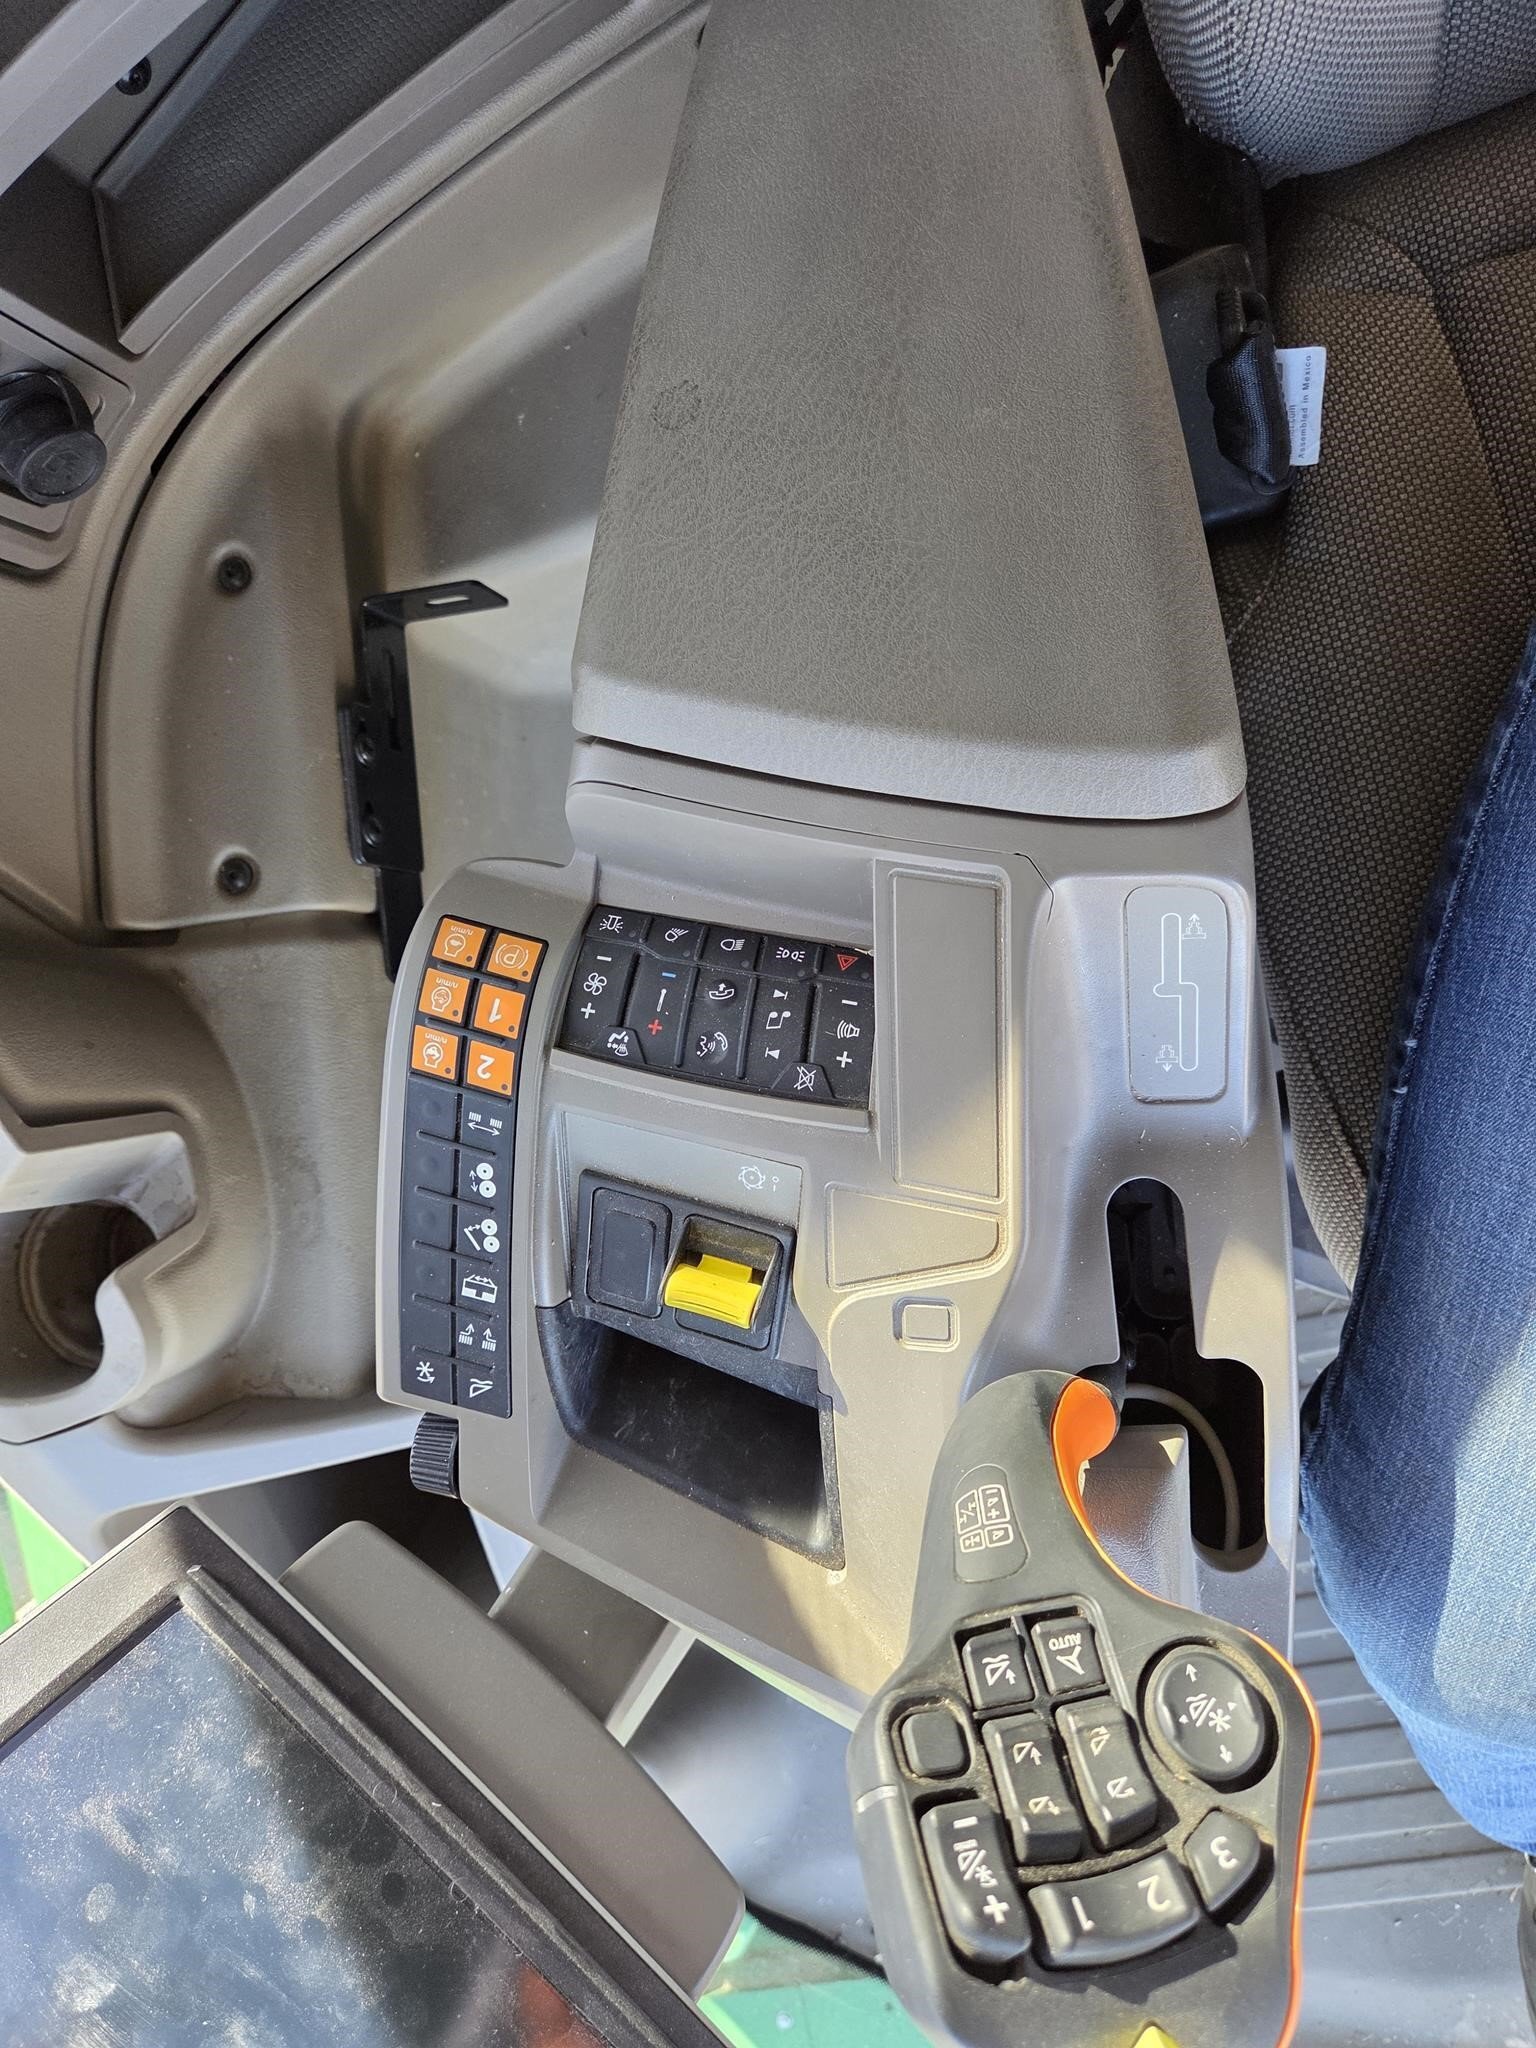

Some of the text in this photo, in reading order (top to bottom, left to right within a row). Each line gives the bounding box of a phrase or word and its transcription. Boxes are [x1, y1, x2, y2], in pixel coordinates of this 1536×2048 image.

[1298, 355, 1312, 459] Assembled in Mexico
[488, 998, 502, 1024] 1
[477, 1054, 495, 1079] 2
[1048, 1632, 1081, 1651] AUTO
[1210, 1836, 1239, 1870] 3
[1137, 1874, 1171, 1912] 2
[1071, 1896, 1095, 1931] 1
